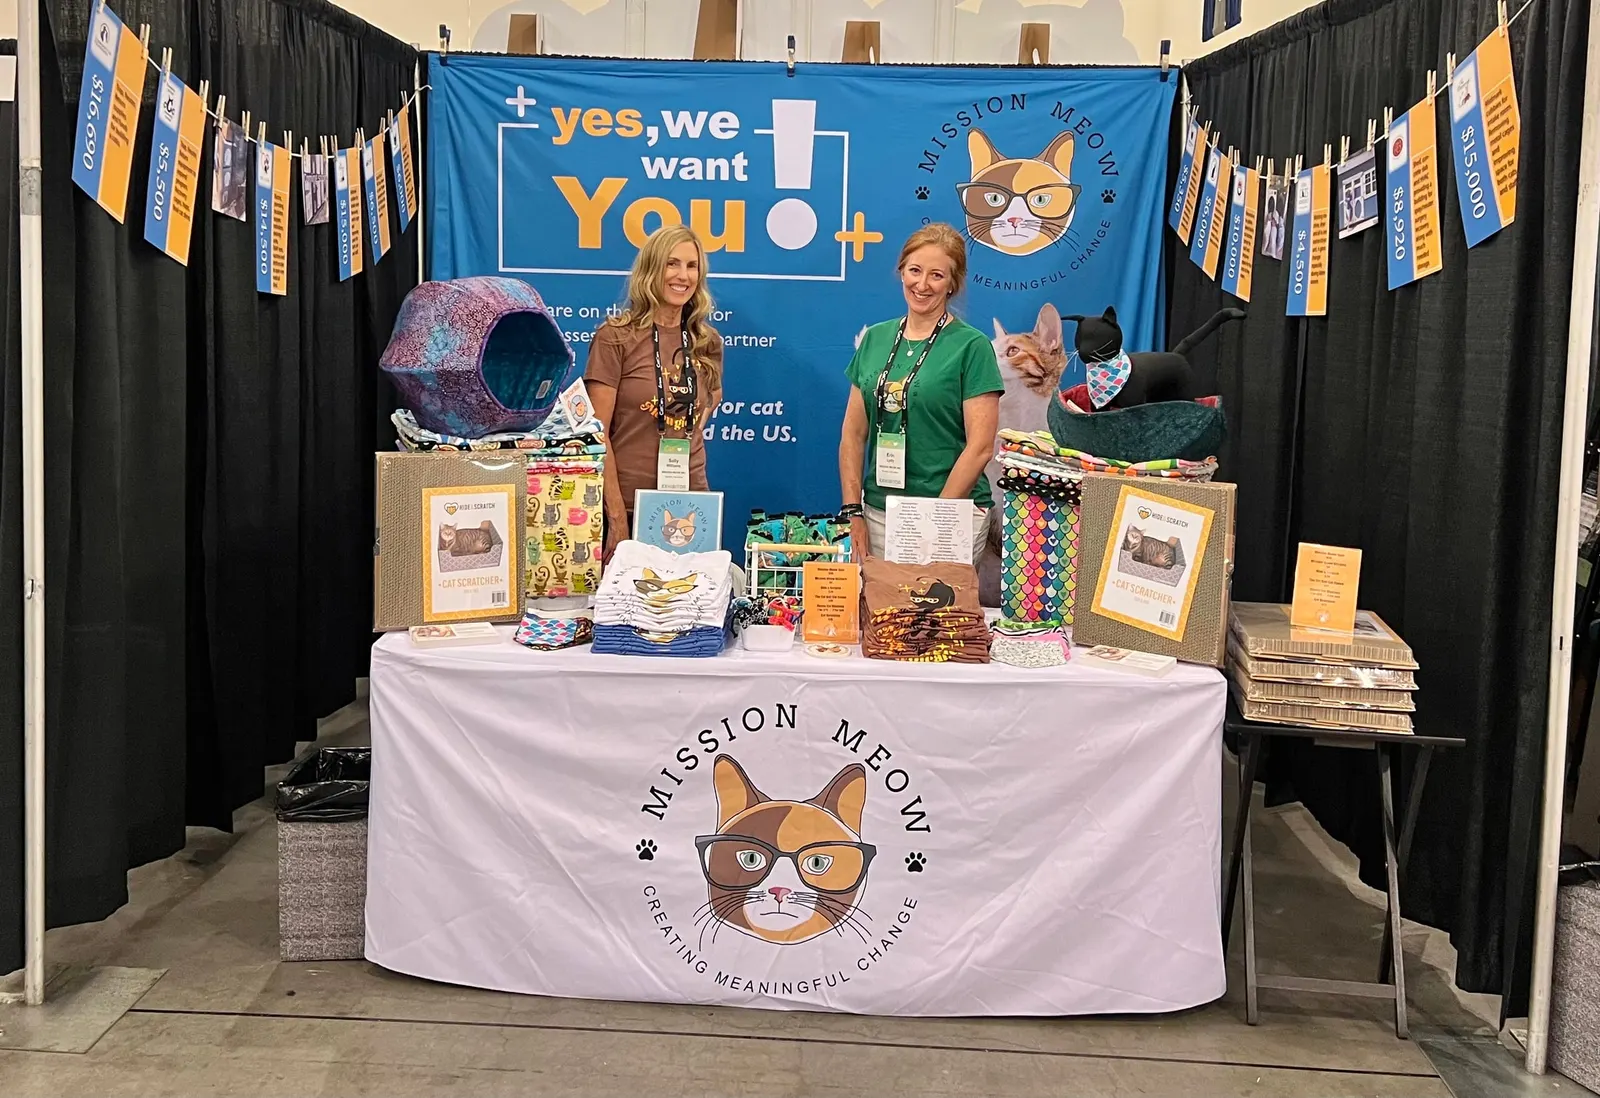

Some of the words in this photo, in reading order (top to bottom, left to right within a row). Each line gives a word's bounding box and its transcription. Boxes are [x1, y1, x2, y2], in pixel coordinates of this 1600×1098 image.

[83, 74, 105, 171] $16,690
[918, 93, 1026, 173] MISSION
[1050, 101, 1119, 177] MEOW
[153, 142, 170, 221] $5,500
[640, 151, 748, 181] want
[1175, 164, 1189, 213] $5,350
[1460, 124, 1487, 220] $15,000
[260, 198, 269, 275] $14,500
[340, 199, 350, 265] $15,000
[368, 190, 379, 245] $6,500
[552, 175, 745, 253] You
[1198, 195, 1212, 249] $6,000
[1393, 186, 1406, 261] $8,920
[972, 269, 1067, 290] MEANINGFUL
[1070, 220, 1111, 270] CHANGE
[1228, 215, 1241, 279] $10,000
[1294, 229, 1307, 295] $4,500
[578, 307, 600, 318] on
[721, 424, 755, 441] the
[762, 425, 797, 443] US.
[750, 400, 784, 416] cat
[474, 502, 496, 510] SCRATCH
[649, 499, 682, 523] MISSION
[687, 501, 709, 525] MEOW
[1166, 516, 1189, 528] SCRATCH
[442, 578, 457, 589] CAT
[457, 575, 500, 588] SCRATCHER
[1115, 579, 1130, 590] CAT
[1130, 584, 1173, 605] SCRATCHER
[641, 703, 798, 821] MISSION
[831, 719, 931, 834] MEOW
[643, 885, 708, 974] CREATING
[714, 970, 851, 995] MEANINGFUL
[857, 897, 918, 972] CHANGE
